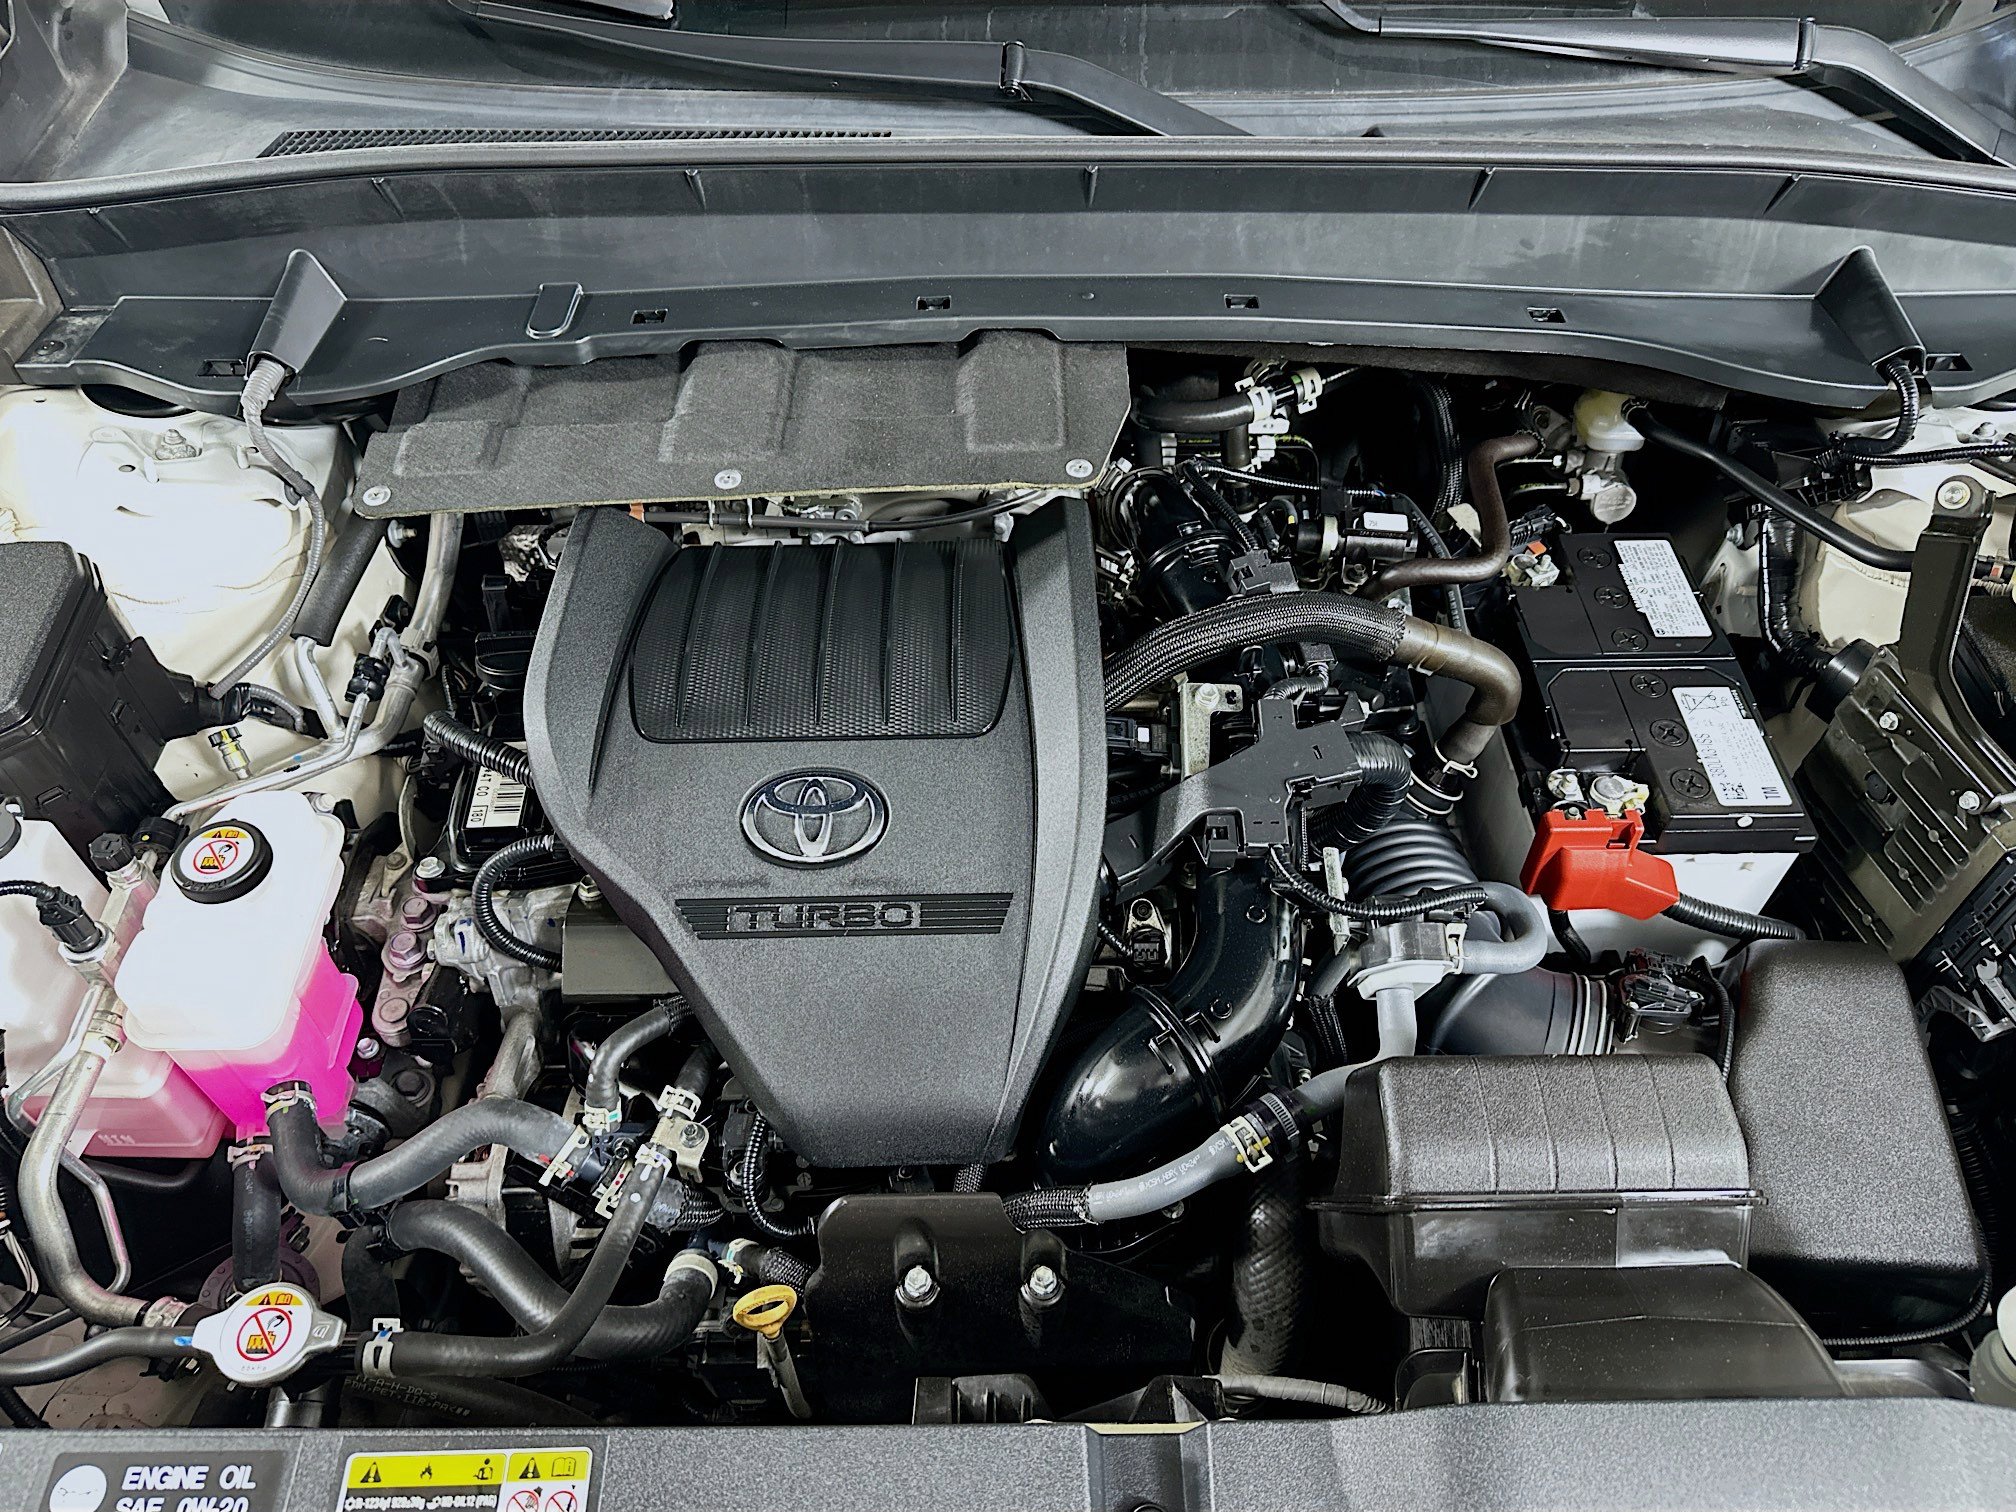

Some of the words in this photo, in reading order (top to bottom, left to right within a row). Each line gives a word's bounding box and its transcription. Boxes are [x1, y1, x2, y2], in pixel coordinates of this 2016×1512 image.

[733, 903, 913, 930] TURBO
[121, 1465, 209, 1491] ENGINE
[219, 1465, 257, 1490] OIL
[115, 1497, 165, 1512] SAE
[175, 1497, 250, 1512] 0W-20
